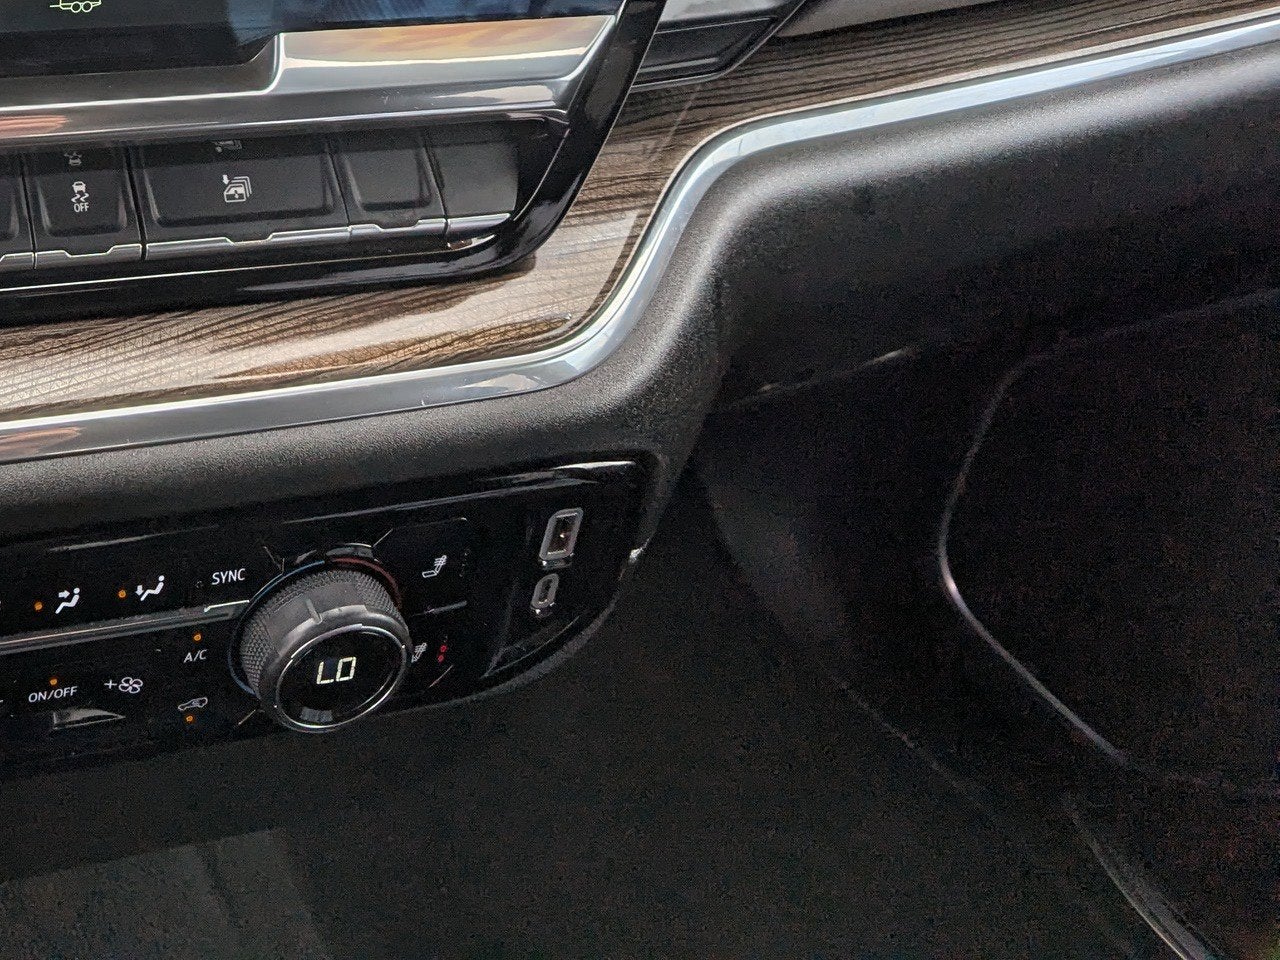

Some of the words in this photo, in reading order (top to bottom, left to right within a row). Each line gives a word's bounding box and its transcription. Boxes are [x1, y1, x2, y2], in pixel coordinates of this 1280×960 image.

[73, 202, 90, 213] OFF
[211, 567, 246, 586] SYNC
[183, 648, 207, 663] A/C
[316, 656, 357, 686] LO
[28, 685, 78, 703] ON/OFF
